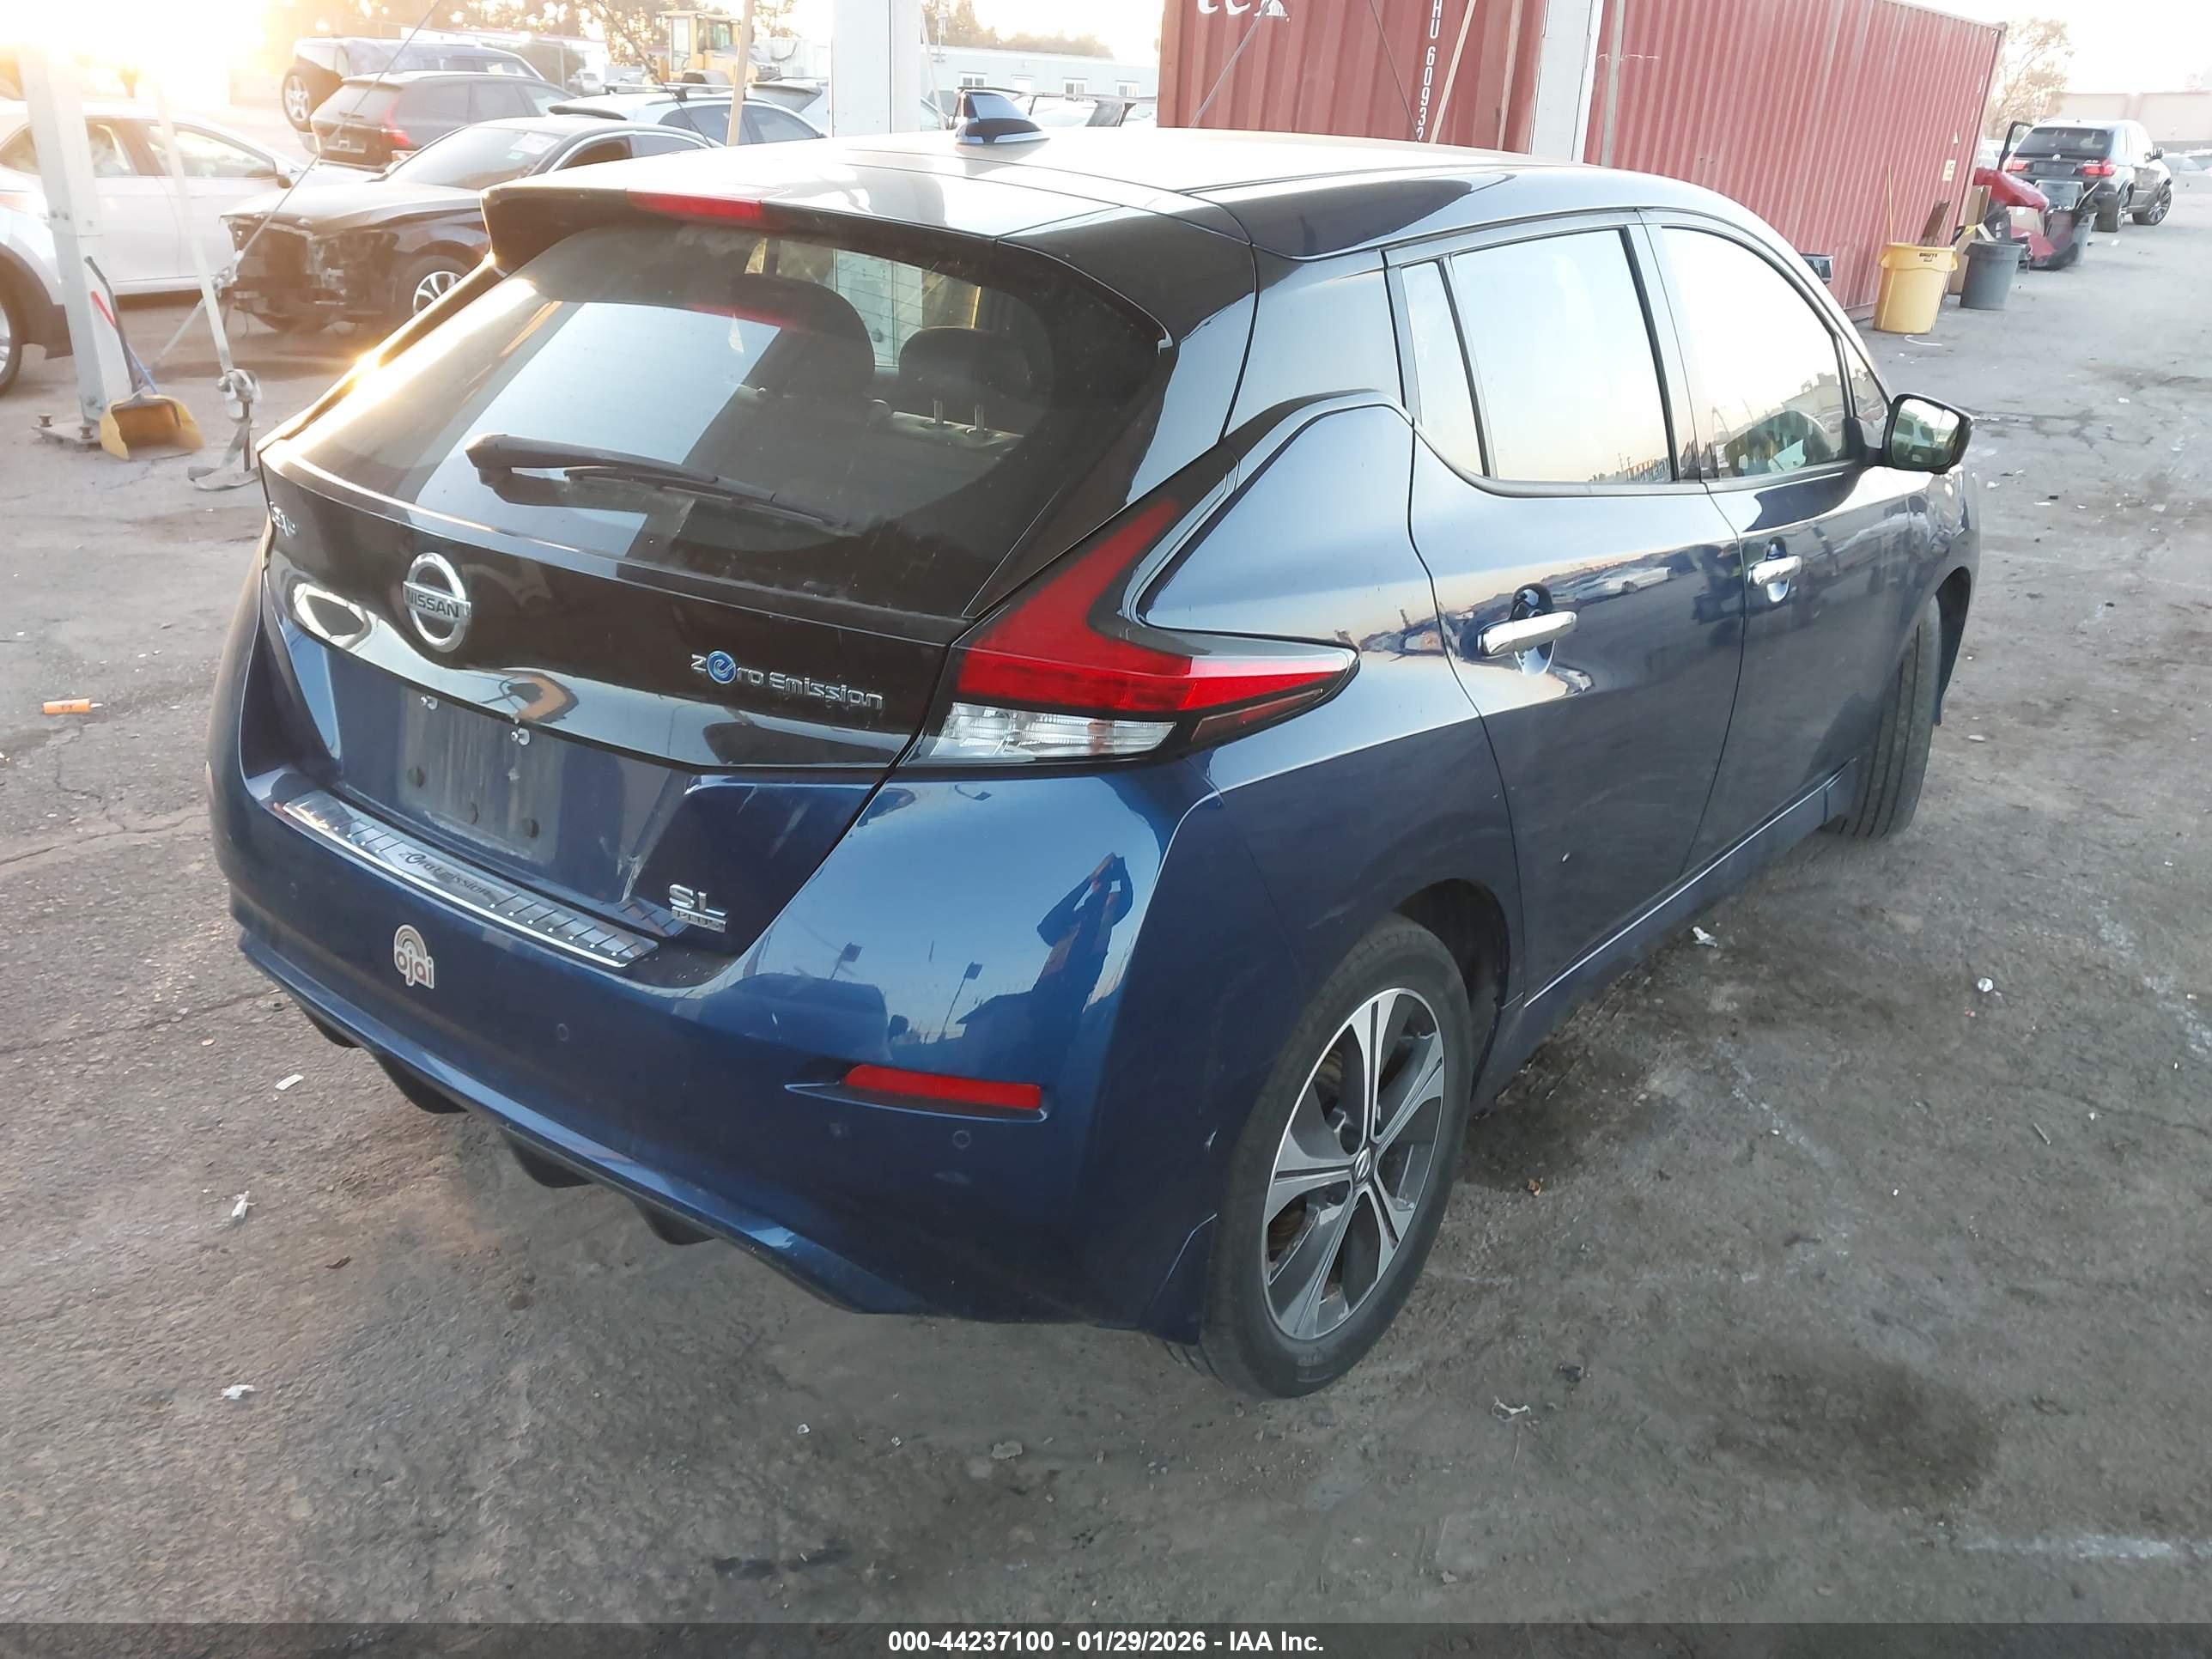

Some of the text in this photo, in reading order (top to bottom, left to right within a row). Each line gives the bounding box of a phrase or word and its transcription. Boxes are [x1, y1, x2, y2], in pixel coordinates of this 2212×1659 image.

[405, 588, 459, 618] NISSAN
[769, 670, 884, 710] Emission
[669, 884, 727, 917] SL
[396, 948, 433, 987] ojai
